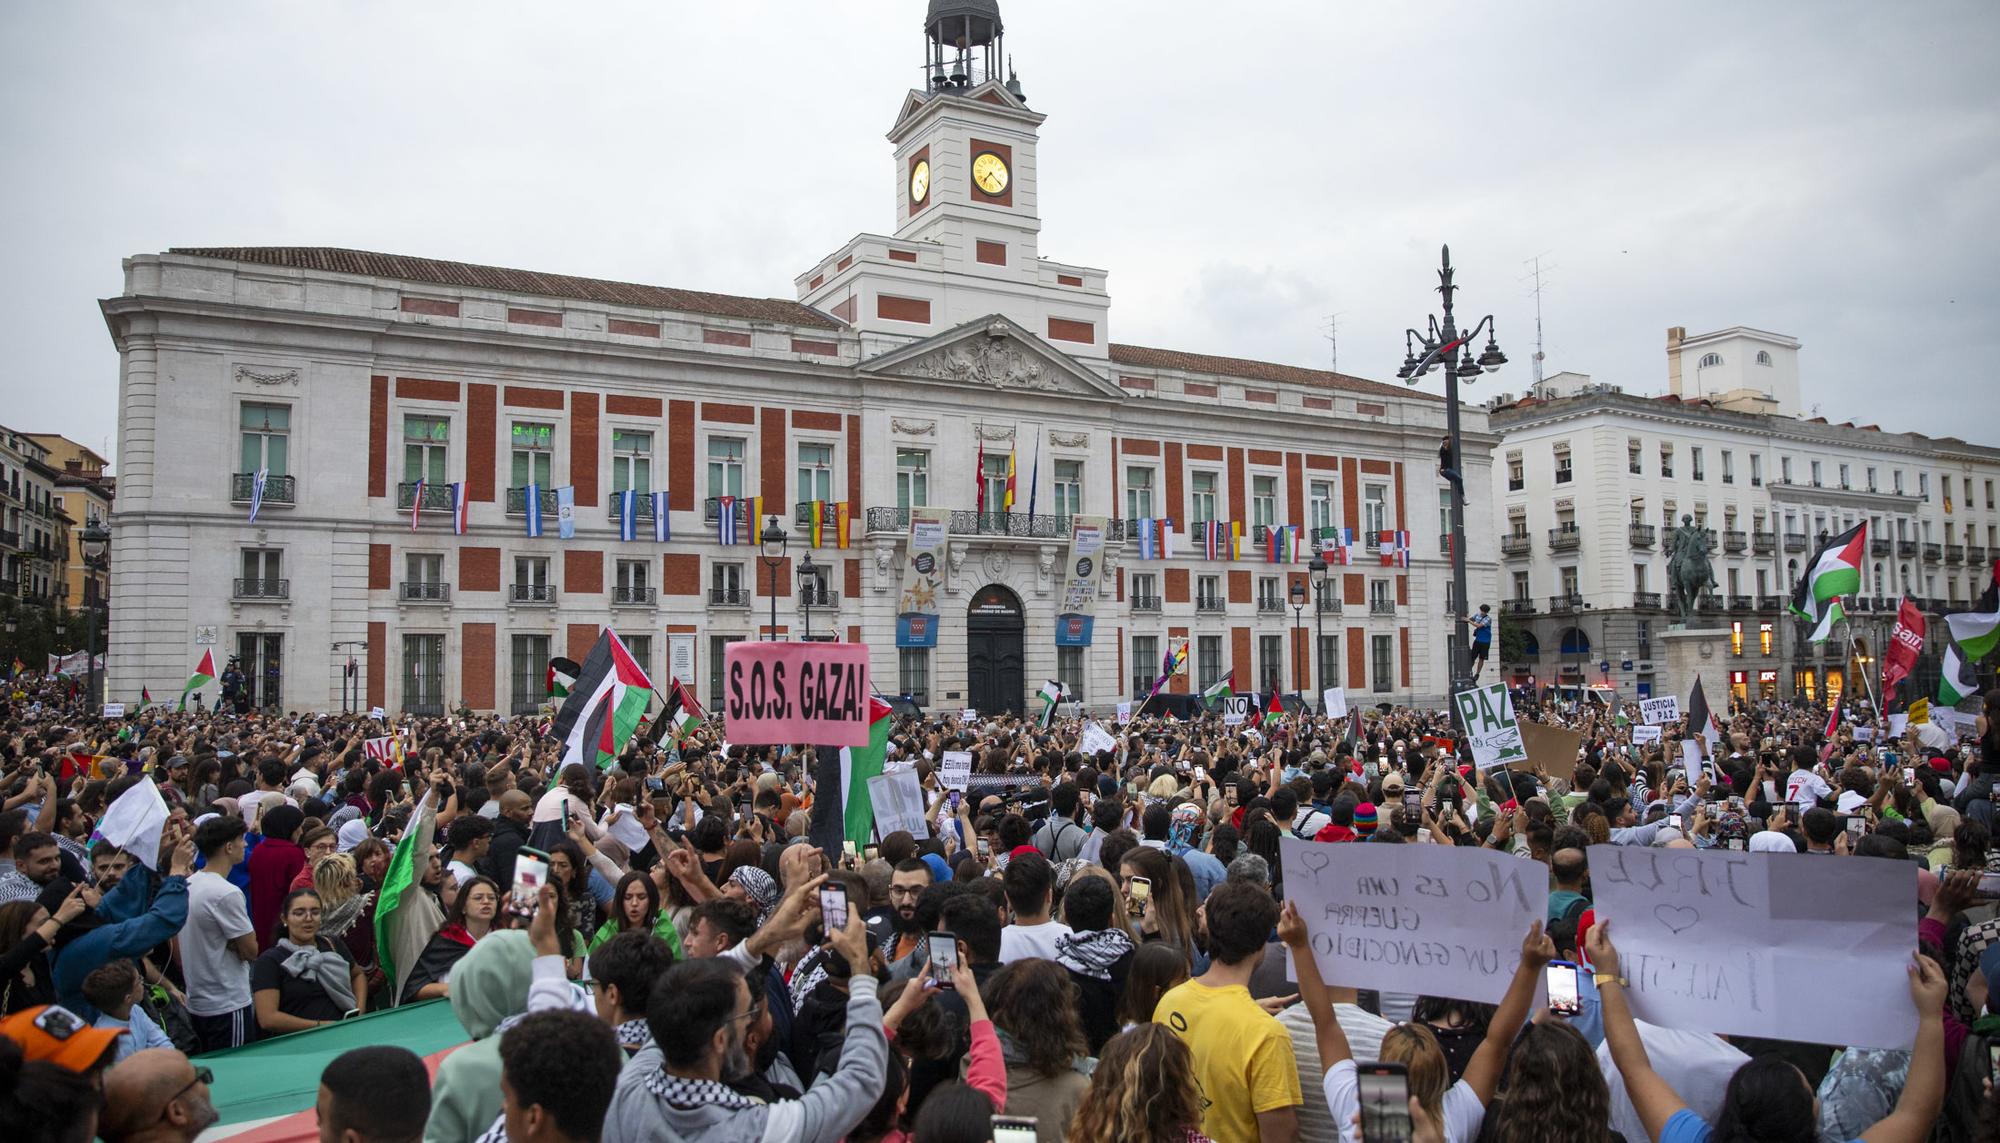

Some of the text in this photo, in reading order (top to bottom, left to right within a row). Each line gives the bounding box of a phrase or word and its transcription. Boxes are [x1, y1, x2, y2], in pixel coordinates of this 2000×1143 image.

[730, 660, 865, 722] S.O.S. GAZA!
[1225, 698, 1247, 715] NO
[1457, 683, 1517, 737] PAZ
[1643, 698, 1676, 712] JUSTICIA
[1644, 710, 1678, 722] Y PAZ.
[1788, 784, 1800, 801] 7
